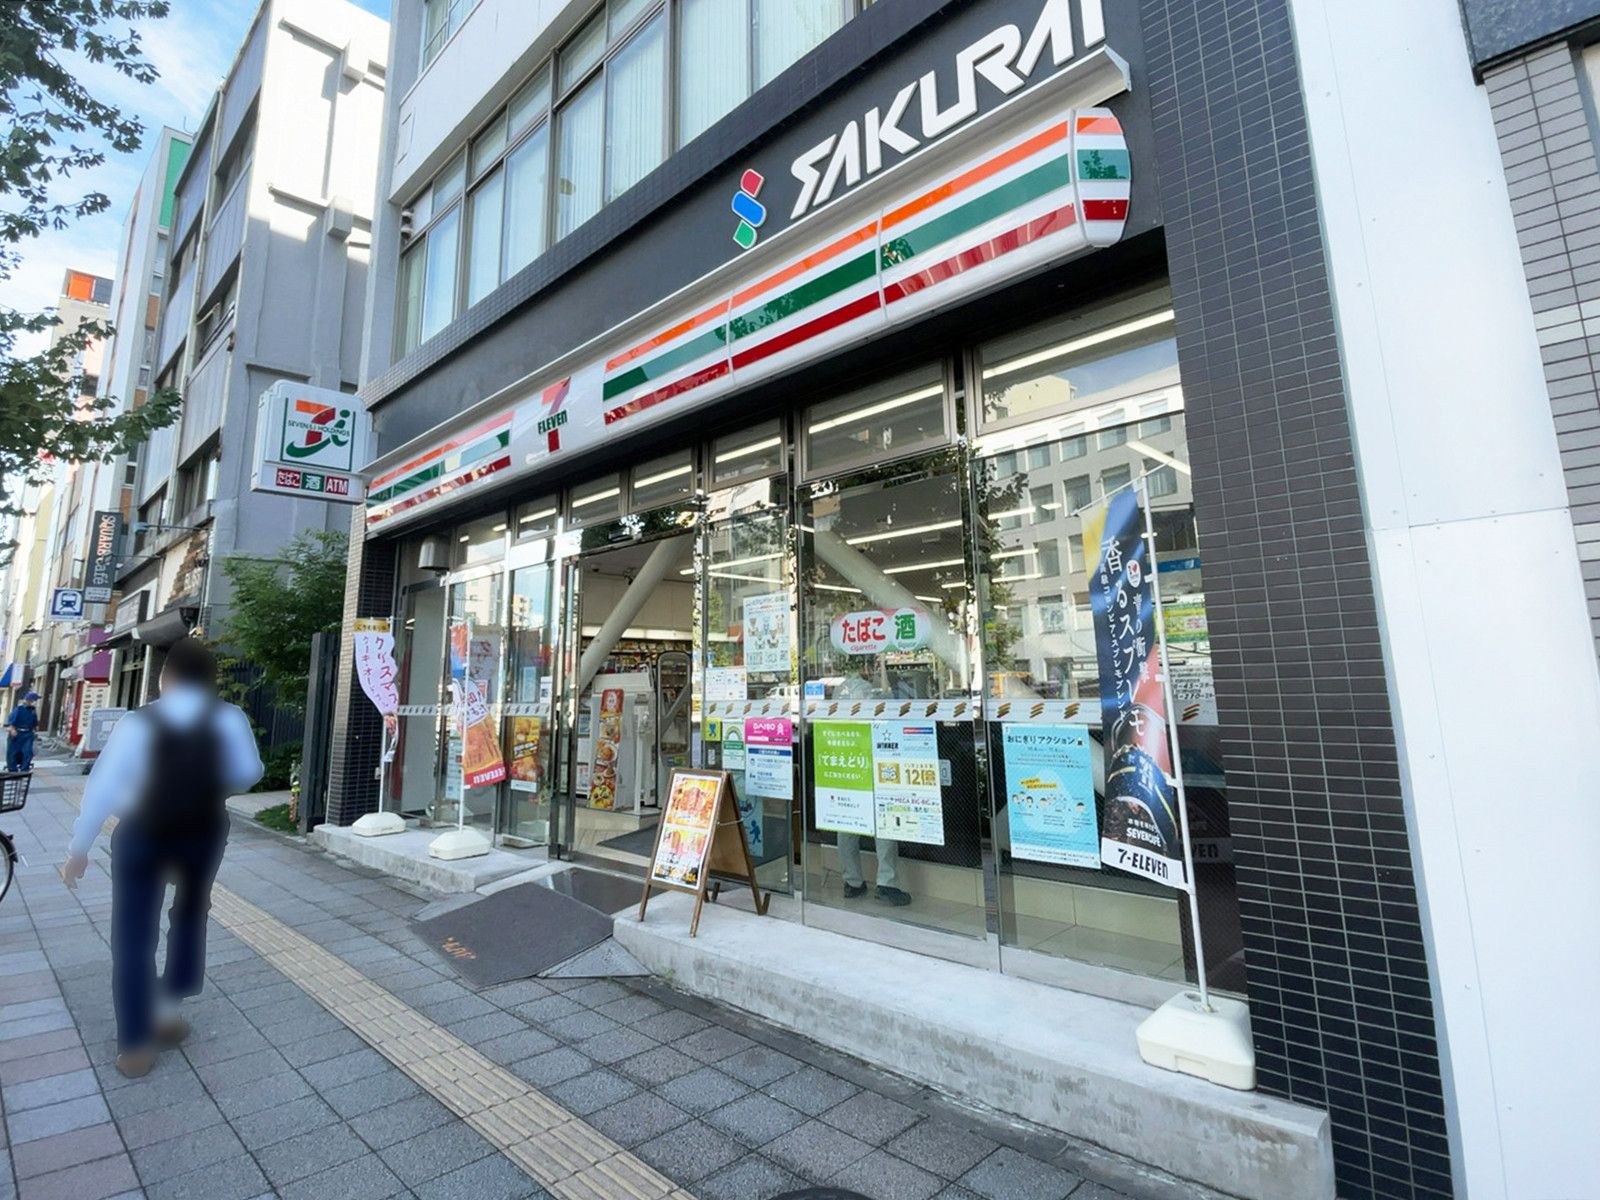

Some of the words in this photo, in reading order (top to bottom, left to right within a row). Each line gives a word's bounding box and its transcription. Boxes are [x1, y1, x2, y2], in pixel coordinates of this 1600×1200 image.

[790, 0, 1106, 220] SAKURAI
[277, 471, 300, 487] たばこ
[305, 475, 321, 490] 酒
[326, 479, 348, 495] ATM
[842, 617, 886, 643] たばこ
[895, 614, 915, 640] 酒
[1007, 735, 1075, 746] おにぎりアクション
[904, 768, 937, 787] 12億
